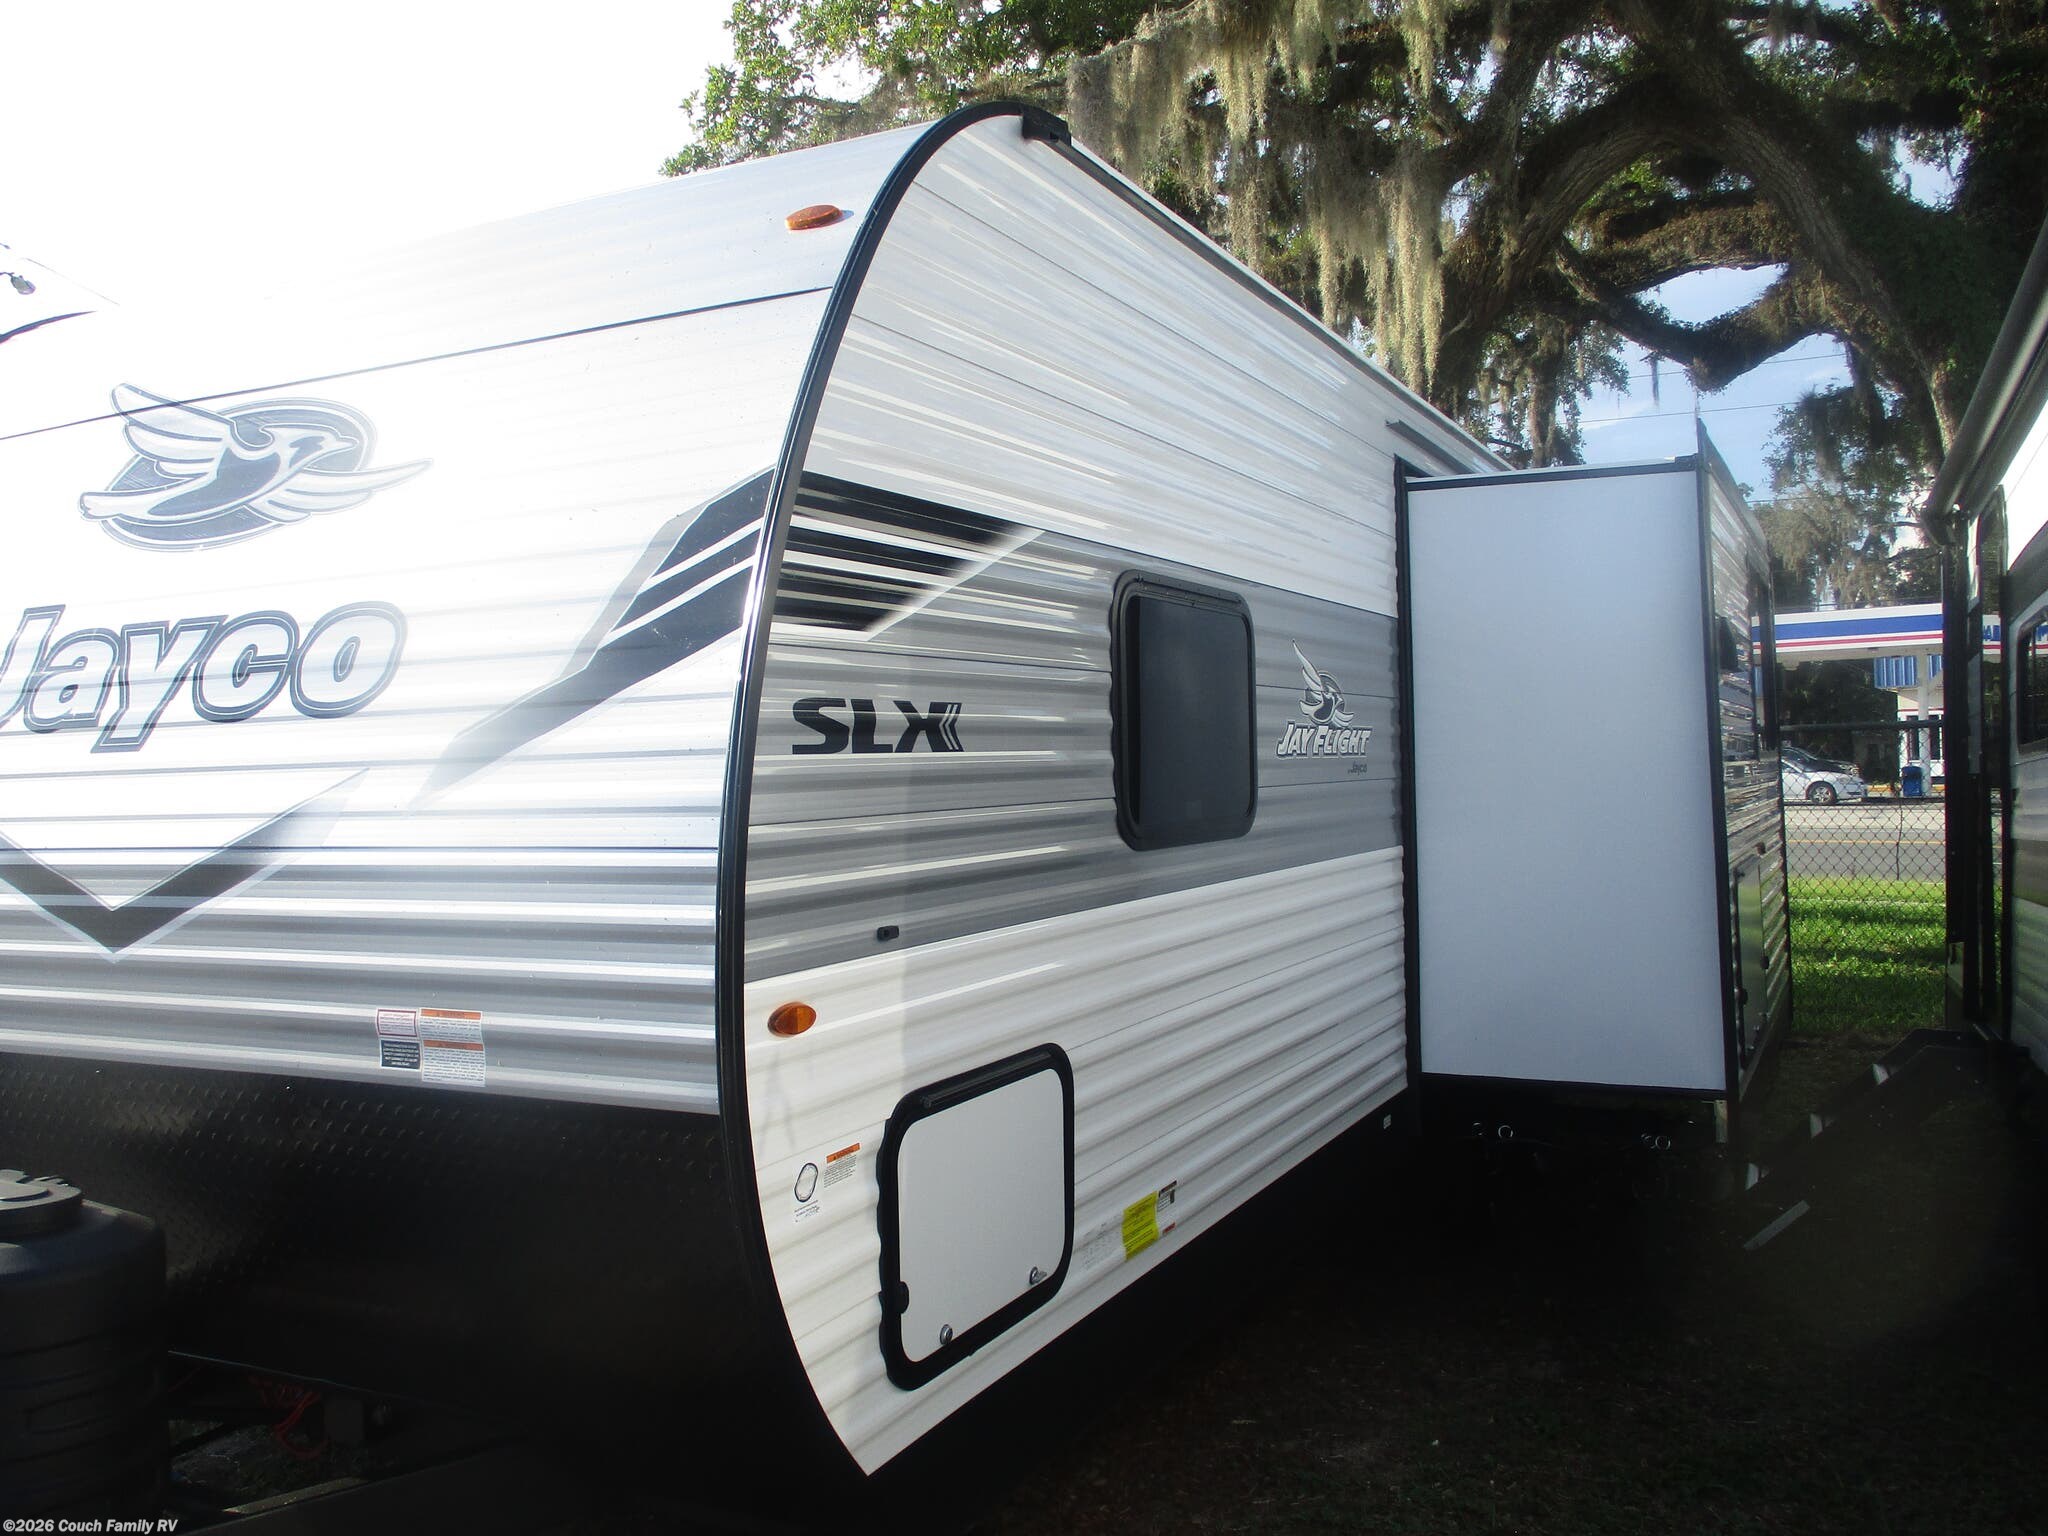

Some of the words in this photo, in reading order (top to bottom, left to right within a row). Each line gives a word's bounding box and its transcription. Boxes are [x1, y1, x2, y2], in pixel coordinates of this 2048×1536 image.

[0, 601, 408, 753] Jayco
[792, 697, 965, 755] SLX
[1277, 720, 1315, 758] JAY
[1312, 725, 1373, 758] FLIGHT
